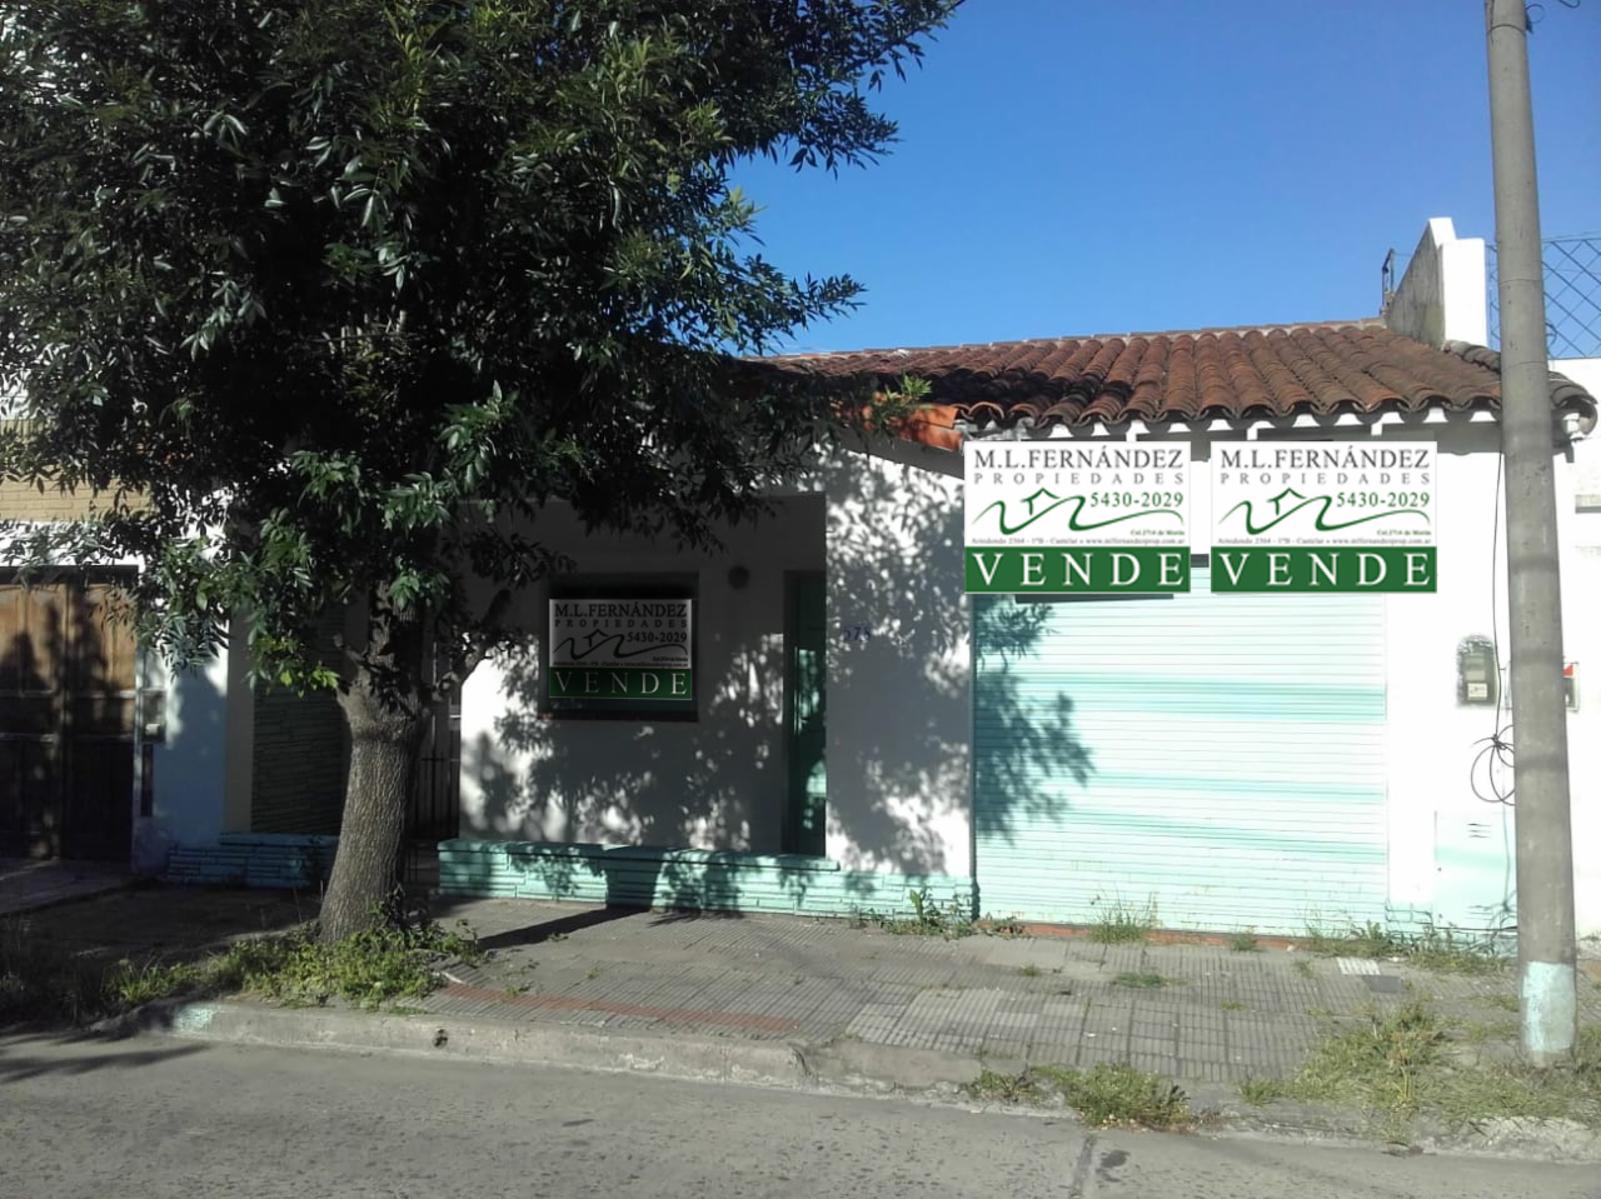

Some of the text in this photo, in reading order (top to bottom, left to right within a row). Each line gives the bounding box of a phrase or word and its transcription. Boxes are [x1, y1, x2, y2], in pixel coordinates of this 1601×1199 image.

[555, 602, 687, 618] M.L.FERNÁNDEZ
[555, 619, 687, 629] PROPIEDADES
[627, 631, 687, 643] 5430-2029
[554, 671, 687, 695] VENDE
